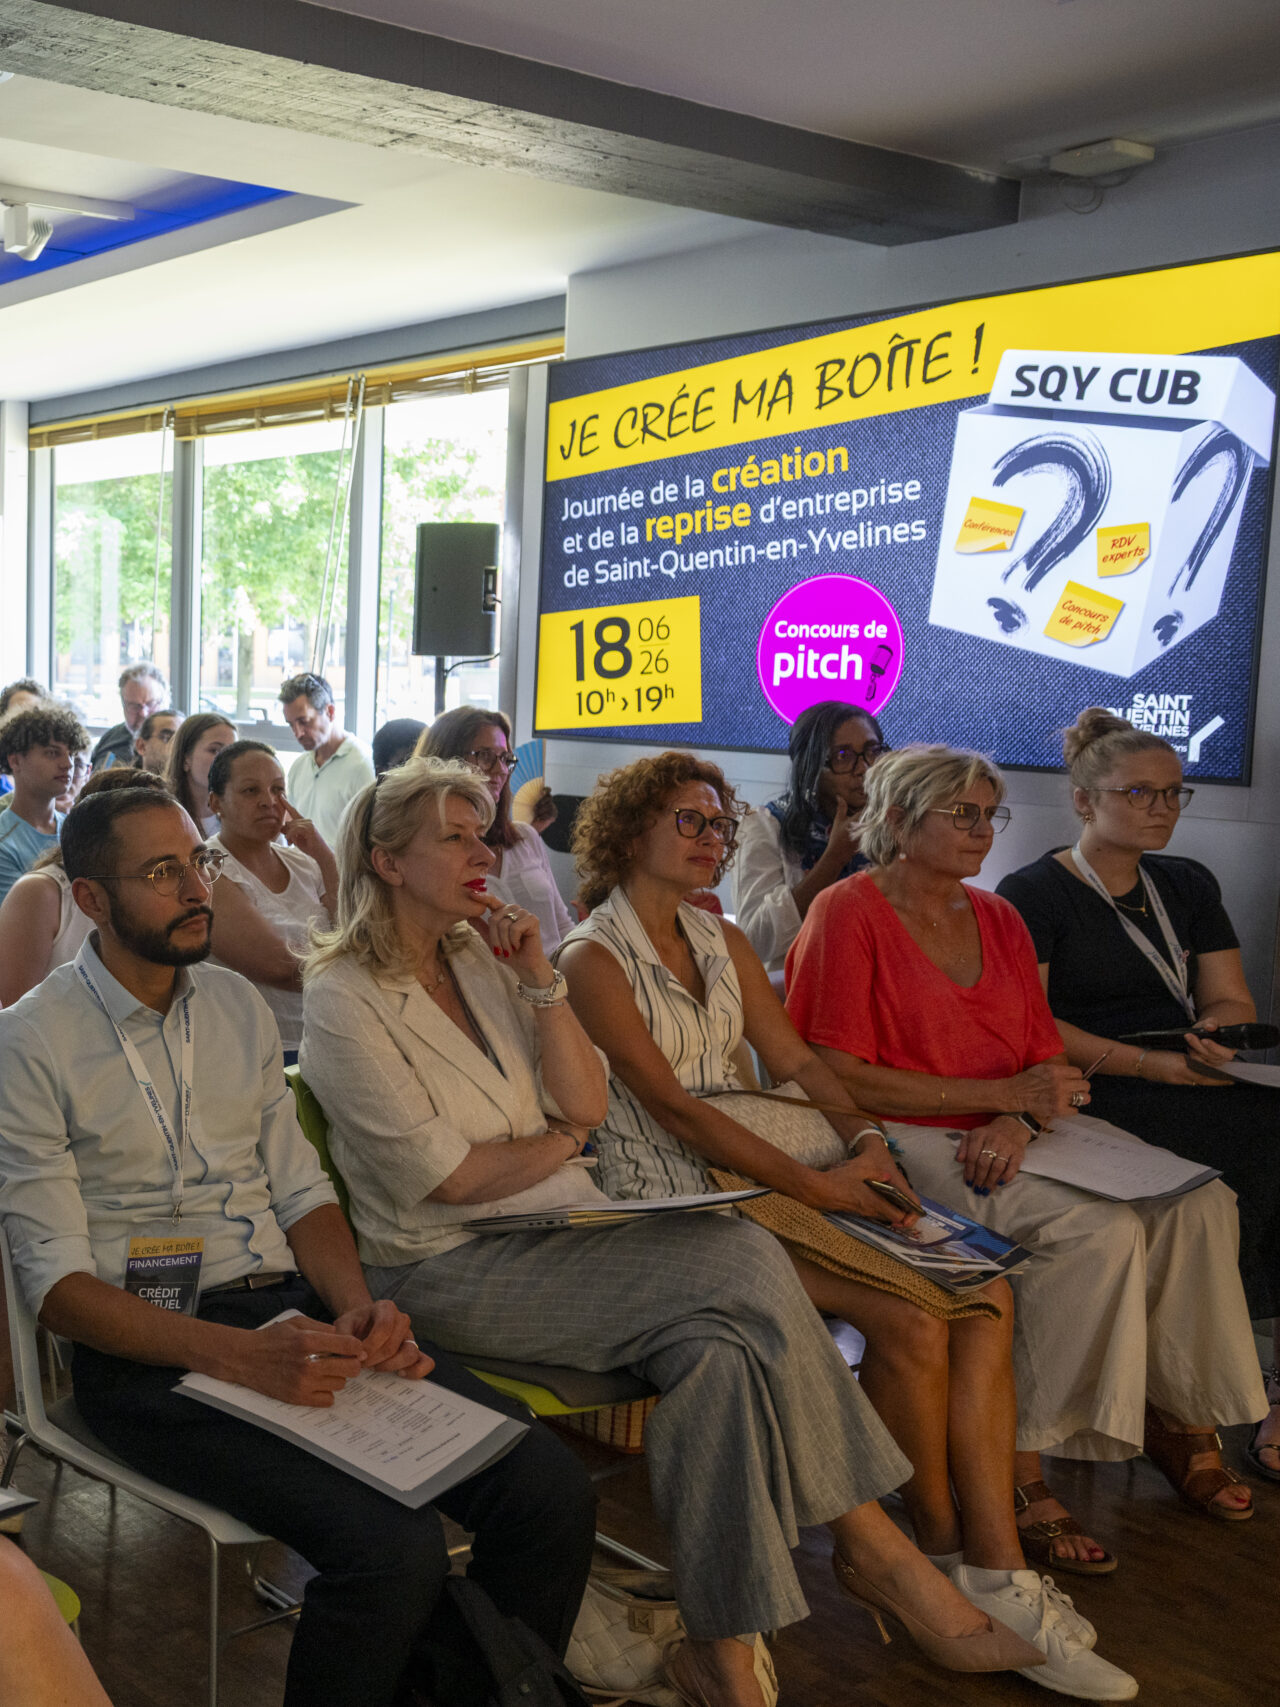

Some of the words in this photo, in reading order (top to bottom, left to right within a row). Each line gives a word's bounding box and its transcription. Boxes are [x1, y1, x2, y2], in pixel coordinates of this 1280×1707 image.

[560, 414, 599, 460] JE
[614, 384, 716, 449] CRÉE
[733, 368, 793, 423] MA
[815, 331, 953, 410] BOÎTE
[971, 322, 985, 374] !
[1010, 364, 1101, 401] SQY
[1109, 367, 1201, 405] CUB
[561, 486, 645, 521] Journée
[650, 479, 679, 505] de
[685, 475, 705, 499] la
[711, 446, 849, 494] création
[563, 532, 583, 554] et
[588, 526, 615, 550] de
[621, 522, 639, 546] la
[645, 500, 751, 545] reprise
[759, 478, 921, 523] d'entreprise
[963, 518, 1015, 537] Conférences
[563, 564, 589, 588] de
[595, 518, 926, 585] Saint-Quentin-en-Yvelines
[1110, 534, 1137, 549] RDV
[1102, 546, 1145, 564] experts
[1062, 600, 1109, 623] Concours
[638, 615, 670, 642] 06
[774, 620, 860, 638] Concours
[863, 620, 888, 638] de
[1059, 614, 1073, 626] de
[1071, 617, 1101, 635] pitch
[570, 616, 632, 682] 18
[640, 648, 669, 675] 26
[772, 644, 863, 686] pitch
[1132, 693, 1193, 711] SAINT
[1131, 723, 1189, 737] VELINES
[129, 1255, 198, 1269] FINANCEMENT
[138, 1285, 181, 1298] CRÉDIT
